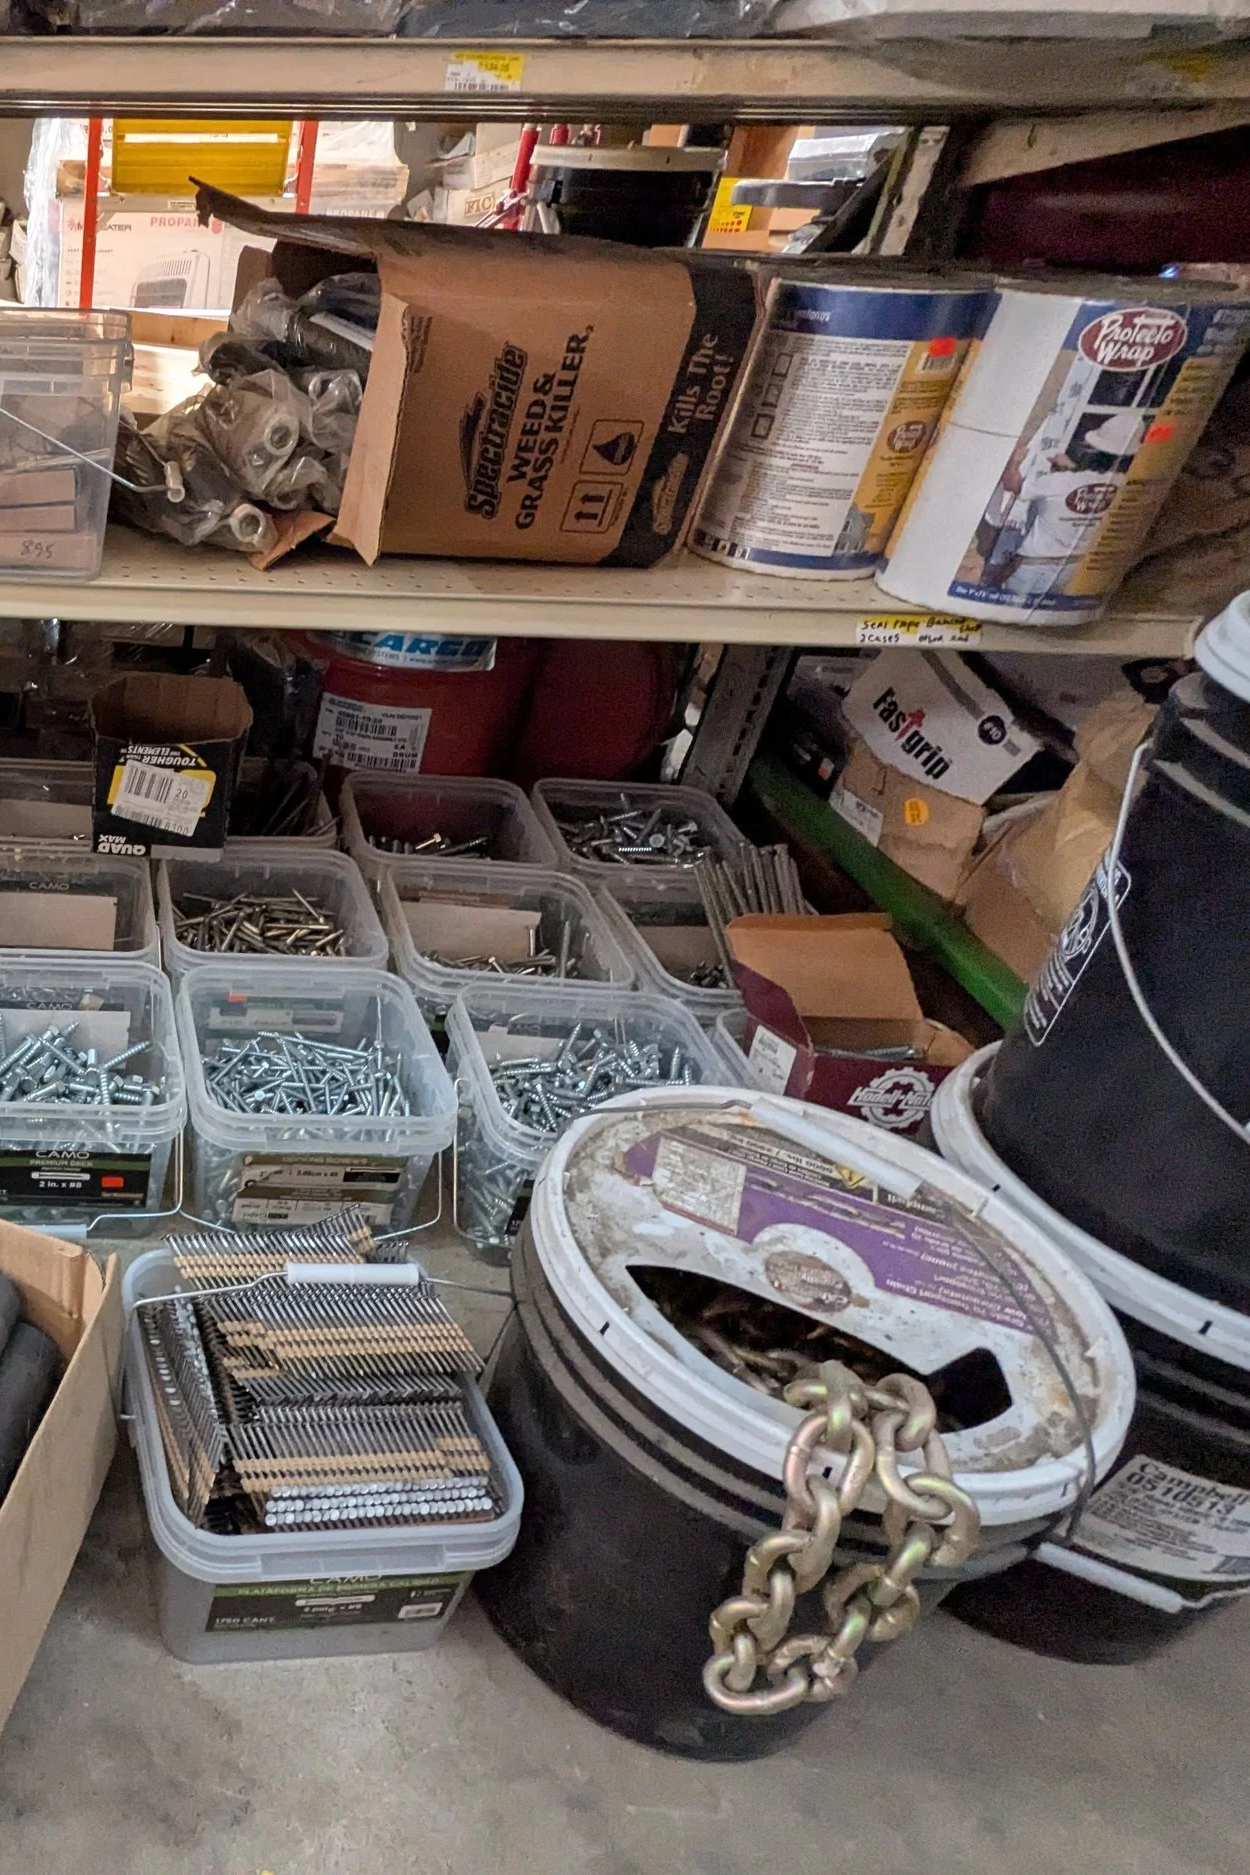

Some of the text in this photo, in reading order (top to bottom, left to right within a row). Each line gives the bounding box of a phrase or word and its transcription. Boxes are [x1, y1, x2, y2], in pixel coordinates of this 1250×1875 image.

[466, 195, 493, 214] FIC
[1094, 309, 1176, 350] Protecto
[1096, 341, 1155, 367] Wrap
[667, 385, 701, 435] Kills
[687, 333, 719, 376] The
[694, 354, 734, 422] Root!
[463, 344, 528, 520] Spectracide
[506, 372, 557, 483] WEED &
[515, 437, 562, 530] GRASS
[127, 744, 171, 756] ELEMENTS
[392, 751, 419, 759] DRUM
[142, 755, 197, 767] TOUGHER
[175, 789, 188, 800] 20
[98, 834, 126, 844] MAX
[98, 842, 147, 856] QUAD
[29, 881, 70, 891] CAMO
[35, 1150, 91, 1160] CAMO
[70, 1160, 94, 1168] DECK
[39, 1181, 46, 1189] 2
[47, 1181, 59, 1189] in.
[69, 1181, 83, 1189] #8
[886, 1280, 918, 1296] Chain
[1139, 1463, 1250, 1507] Campbell
